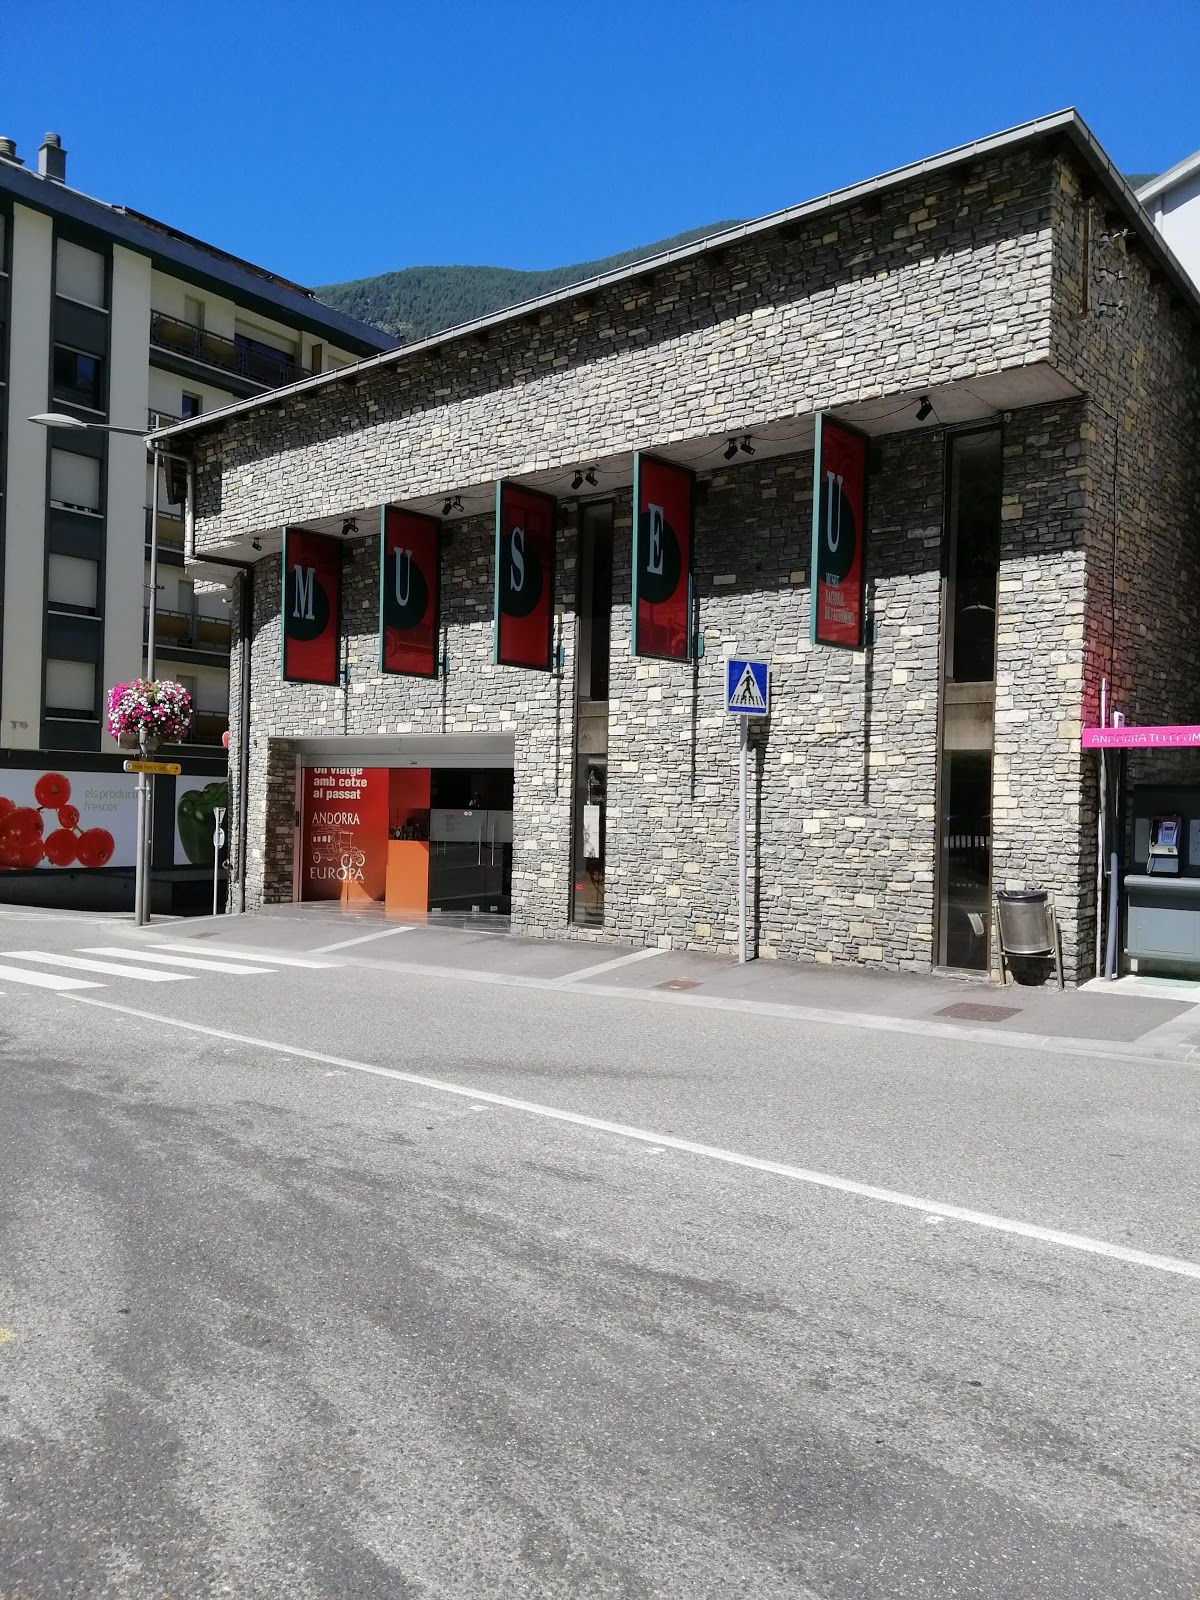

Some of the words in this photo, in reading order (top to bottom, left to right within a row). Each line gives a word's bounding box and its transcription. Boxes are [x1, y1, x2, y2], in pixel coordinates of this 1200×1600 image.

[292, 565, 317, 621] M
[393, 546, 413, 608] U
[510, 527, 525, 592] S
[646, 503, 665, 576] E
[826, 470, 844, 553] U
[1091, 733, 1147, 743] ANDORRA
[313, 776, 336, 787] amb
[338, 777, 368, 788] cotxe
[85, 788, 98, 798] els
[312, 788, 323, 799] al
[325, 790, 361, 800] passat
[85, 801, 118, 811] frescos
[312, 812, 360, 825] ANDORRA
[310, 867, 364, 880] EUROPA
